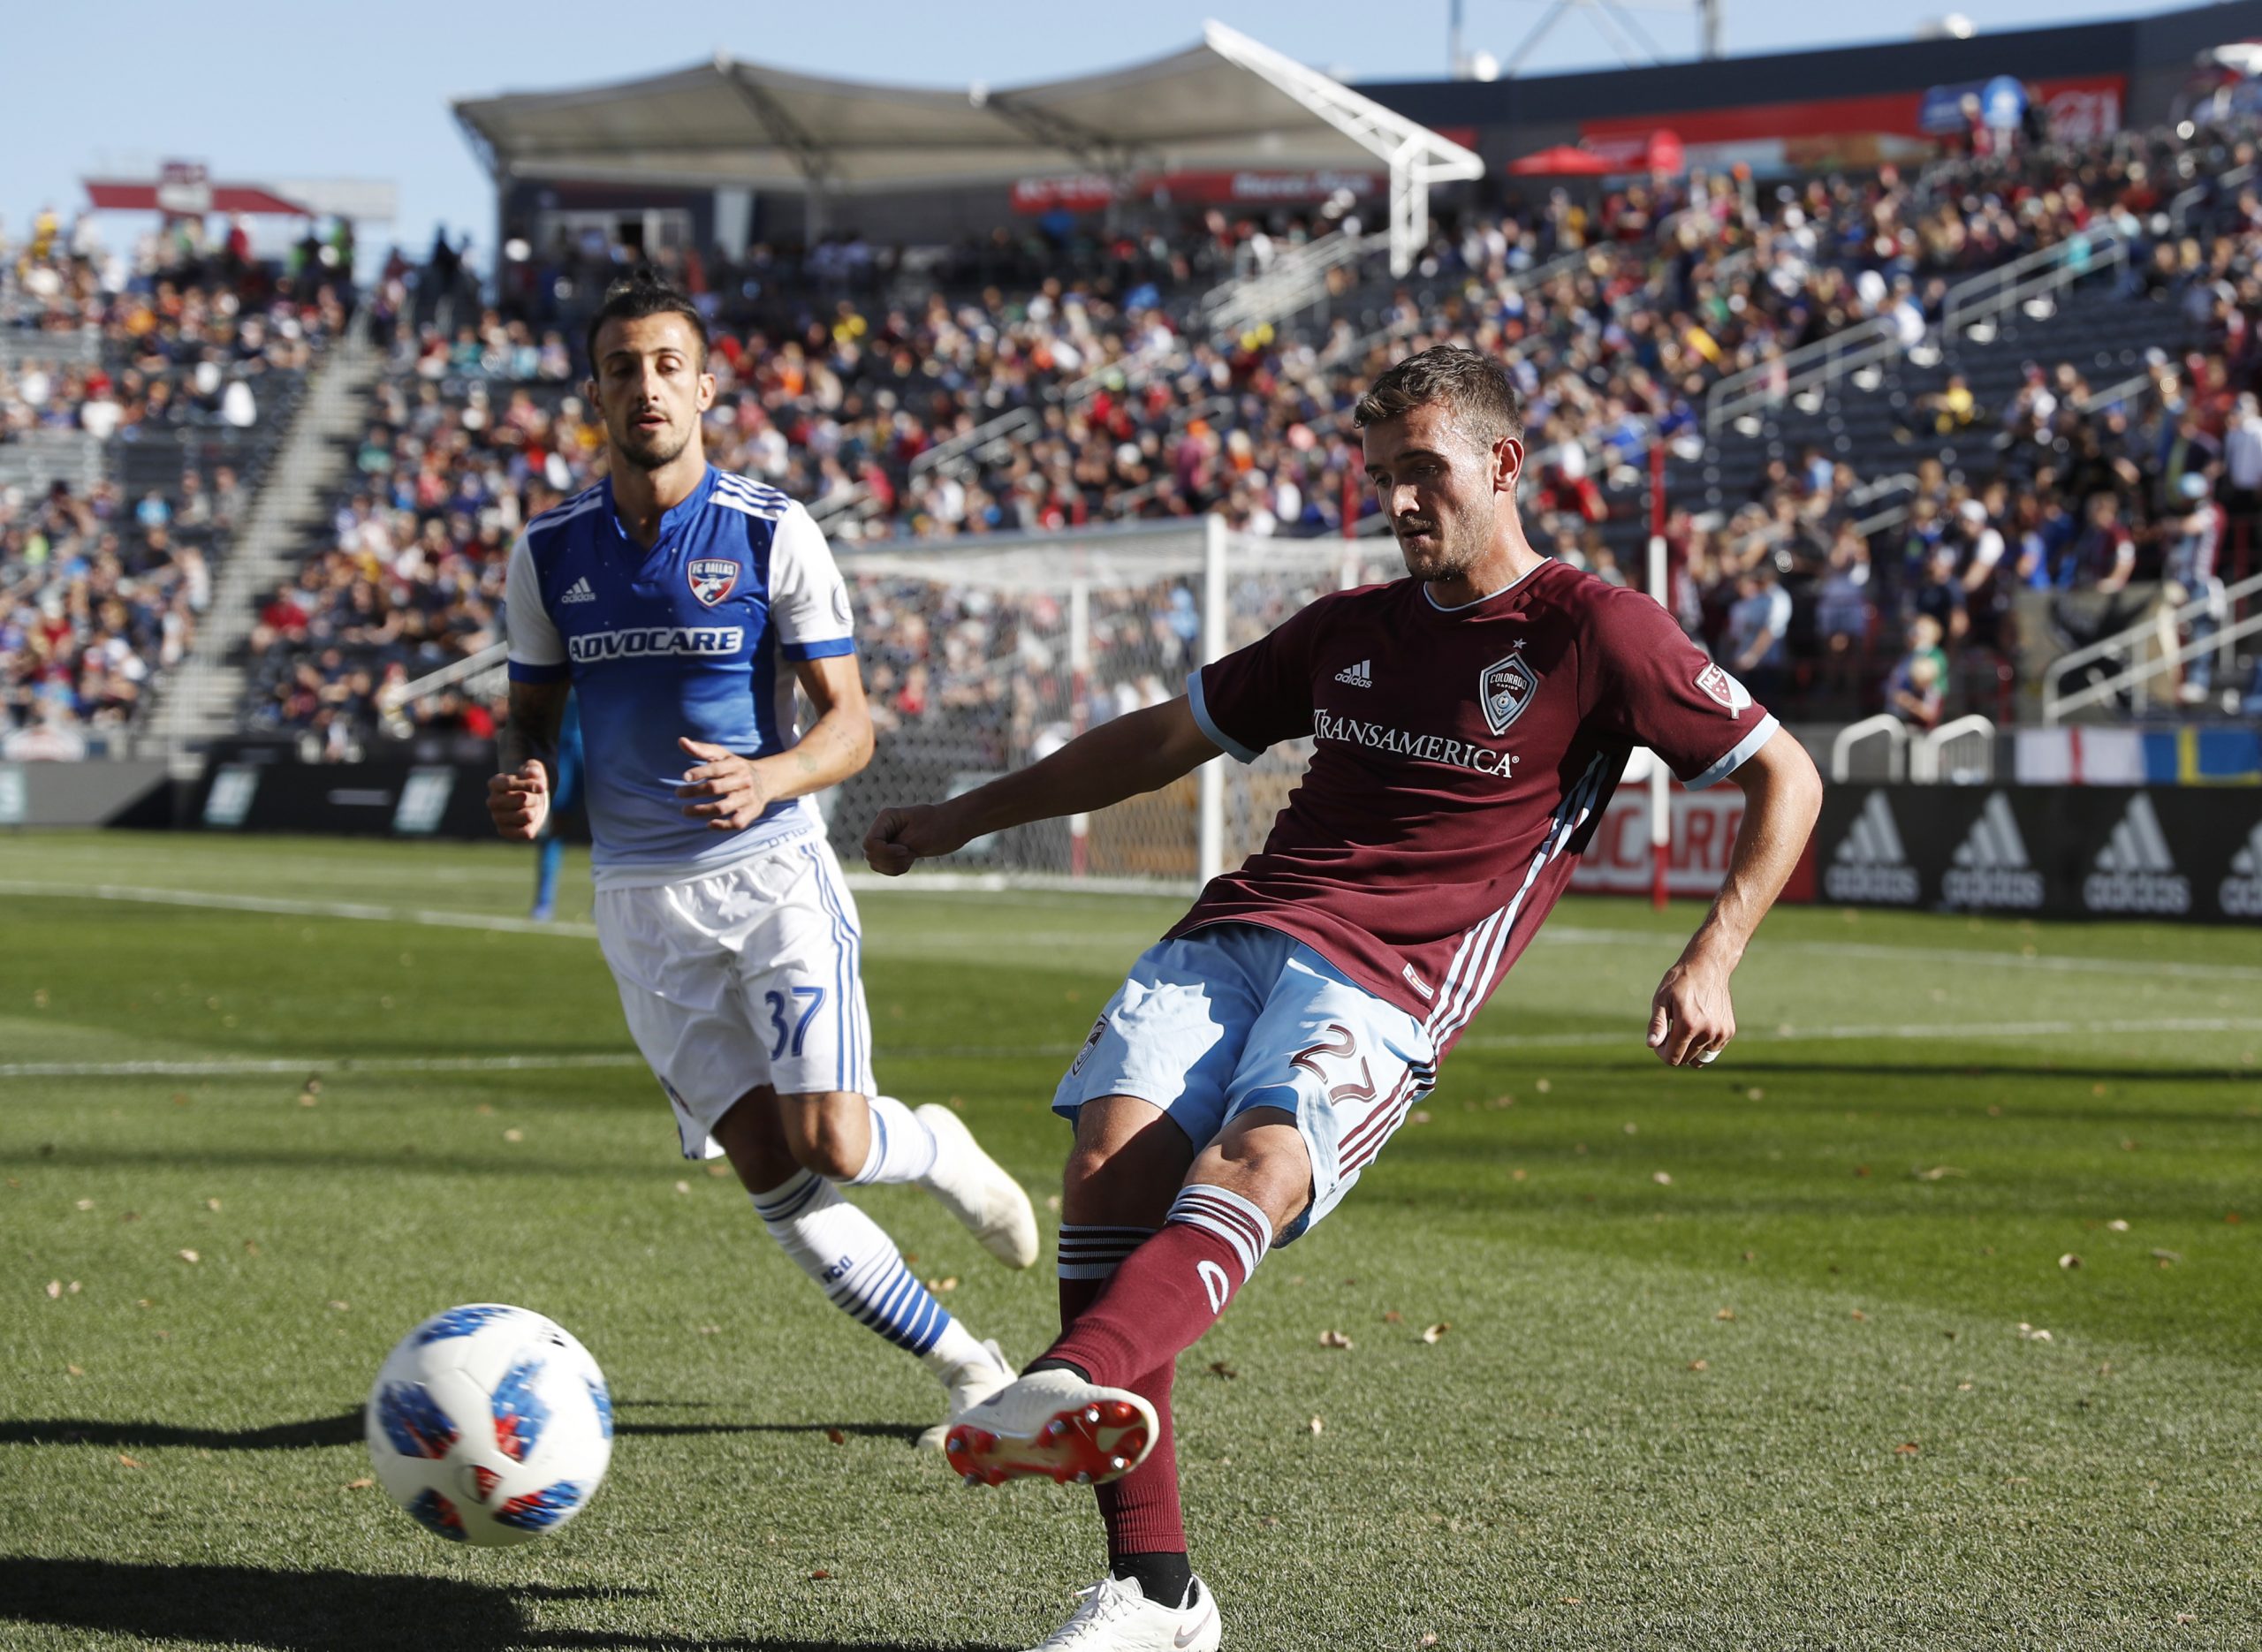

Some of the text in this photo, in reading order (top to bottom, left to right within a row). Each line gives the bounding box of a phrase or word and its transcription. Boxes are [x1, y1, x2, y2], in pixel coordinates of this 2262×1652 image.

[561, 592, 596, 604] adidas
[569, 628, 742, 661] ADVOCARE
[1334, 671, 1372, 689] adidas
[1490, 672, 1528, 690] COLORADO
[1702, 667, 1723, 690] MLS
[764, 987, 826, 1061] 37
[1288, 1024, 1378, 1106] 27
